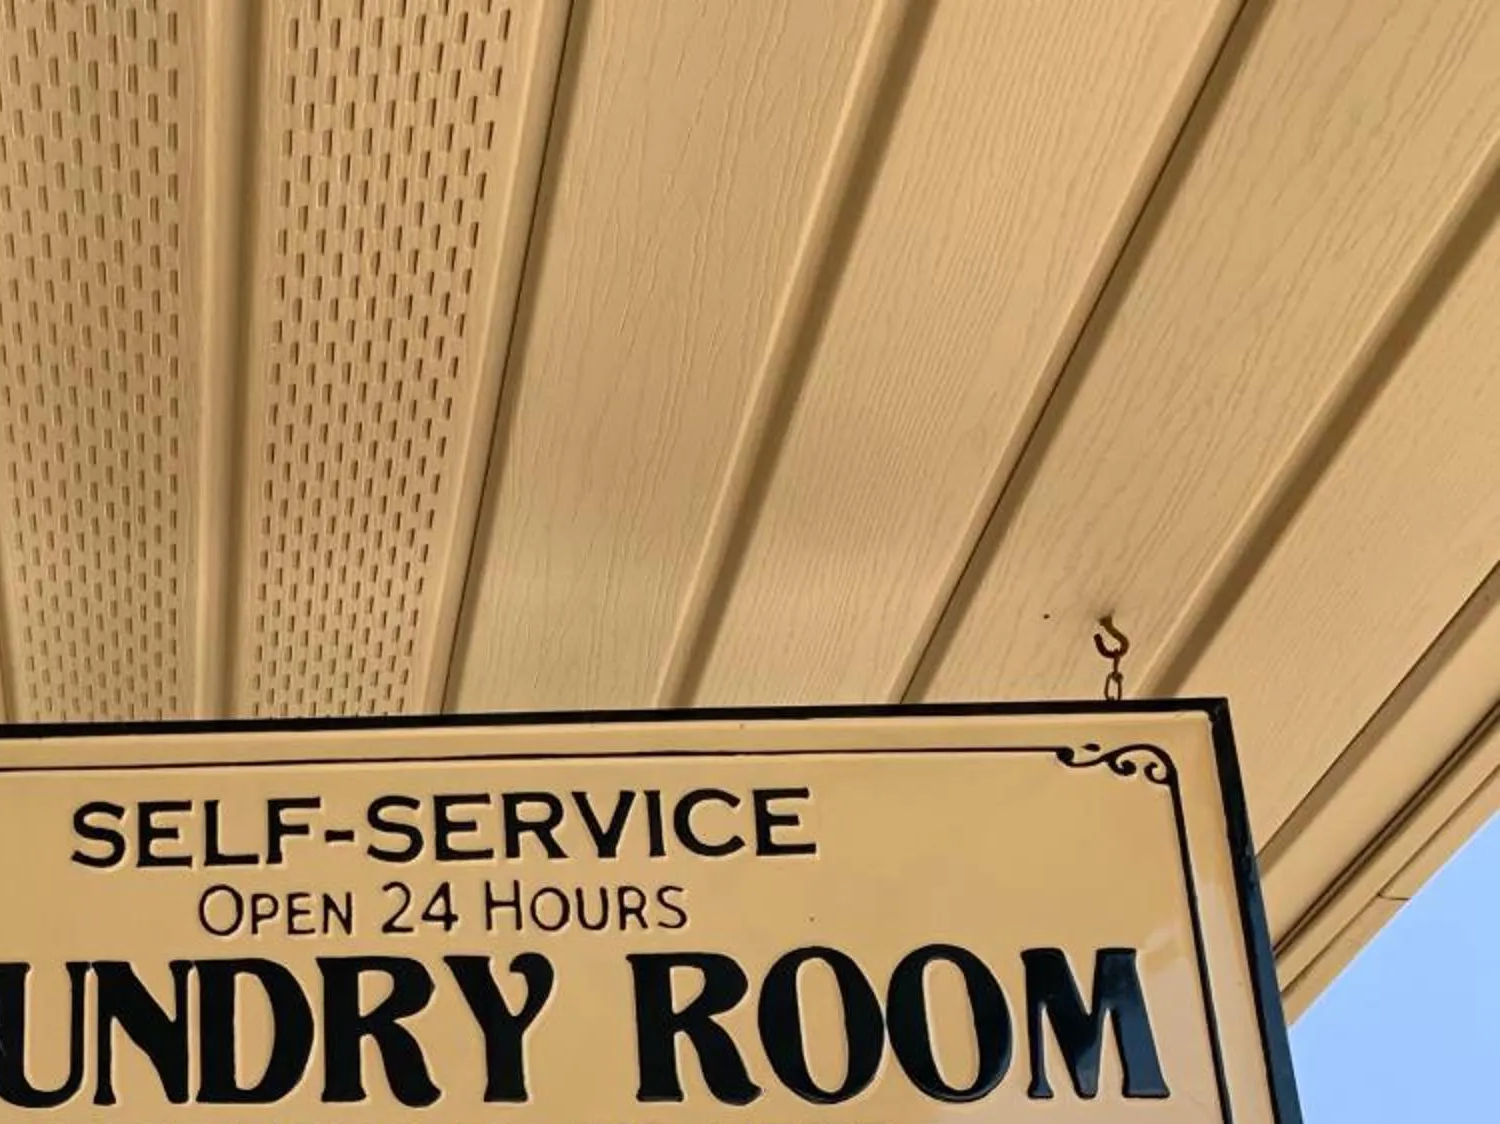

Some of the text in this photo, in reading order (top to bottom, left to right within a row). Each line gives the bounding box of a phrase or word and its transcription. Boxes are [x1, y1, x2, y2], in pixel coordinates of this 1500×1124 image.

[70, 786, 818, 869] SELF-SERVICE
[198, 878, 688, 938] OPEN 24 HOURS
[625, 943, 1171, 1105] ROOM
